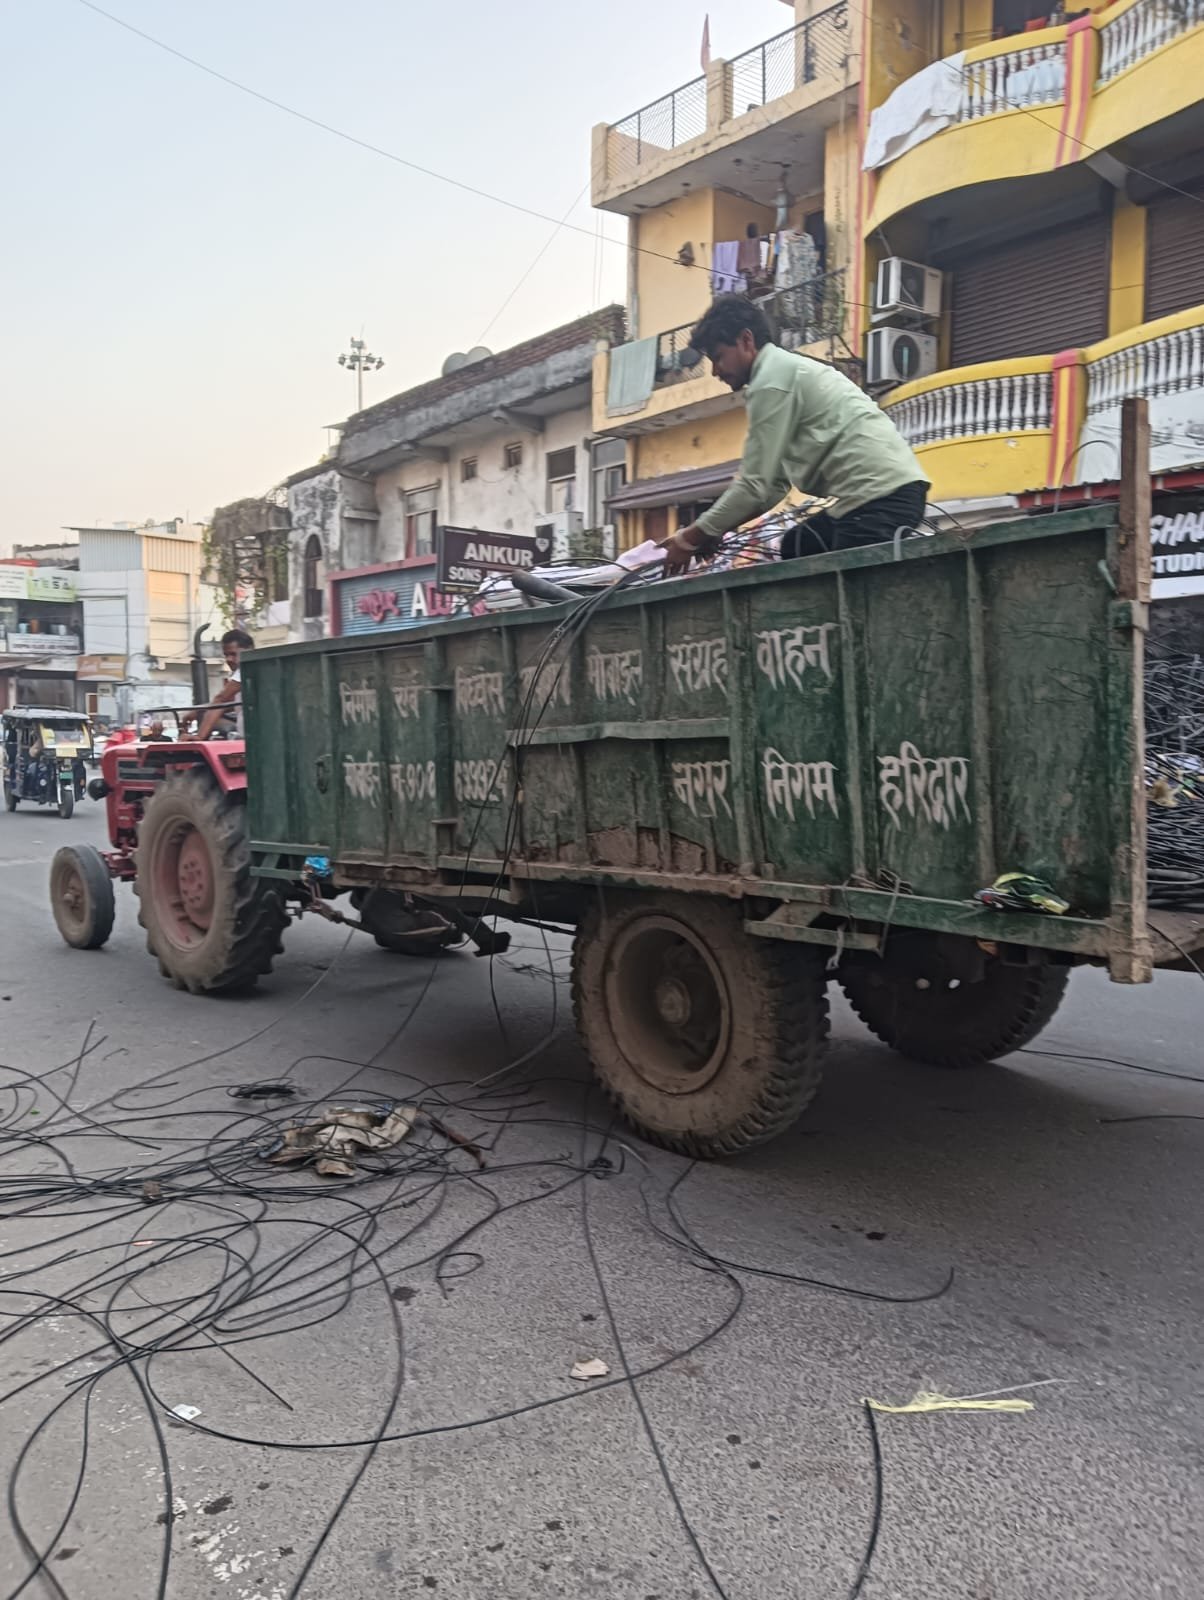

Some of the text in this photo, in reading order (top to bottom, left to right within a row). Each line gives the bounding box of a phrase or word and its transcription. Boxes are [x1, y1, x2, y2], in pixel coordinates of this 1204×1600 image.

[1150, 511, 1204, 546] SHA
[464, 542, 534, 567] ANKUR
[1150, 552, 1204, 574] TUDI
[449, 566, 483, 583] SONS
[755, 622, 840, 693] वाहन
[671, 759, 733, 819] नगर
[761, 747, 839, 821] निगम
